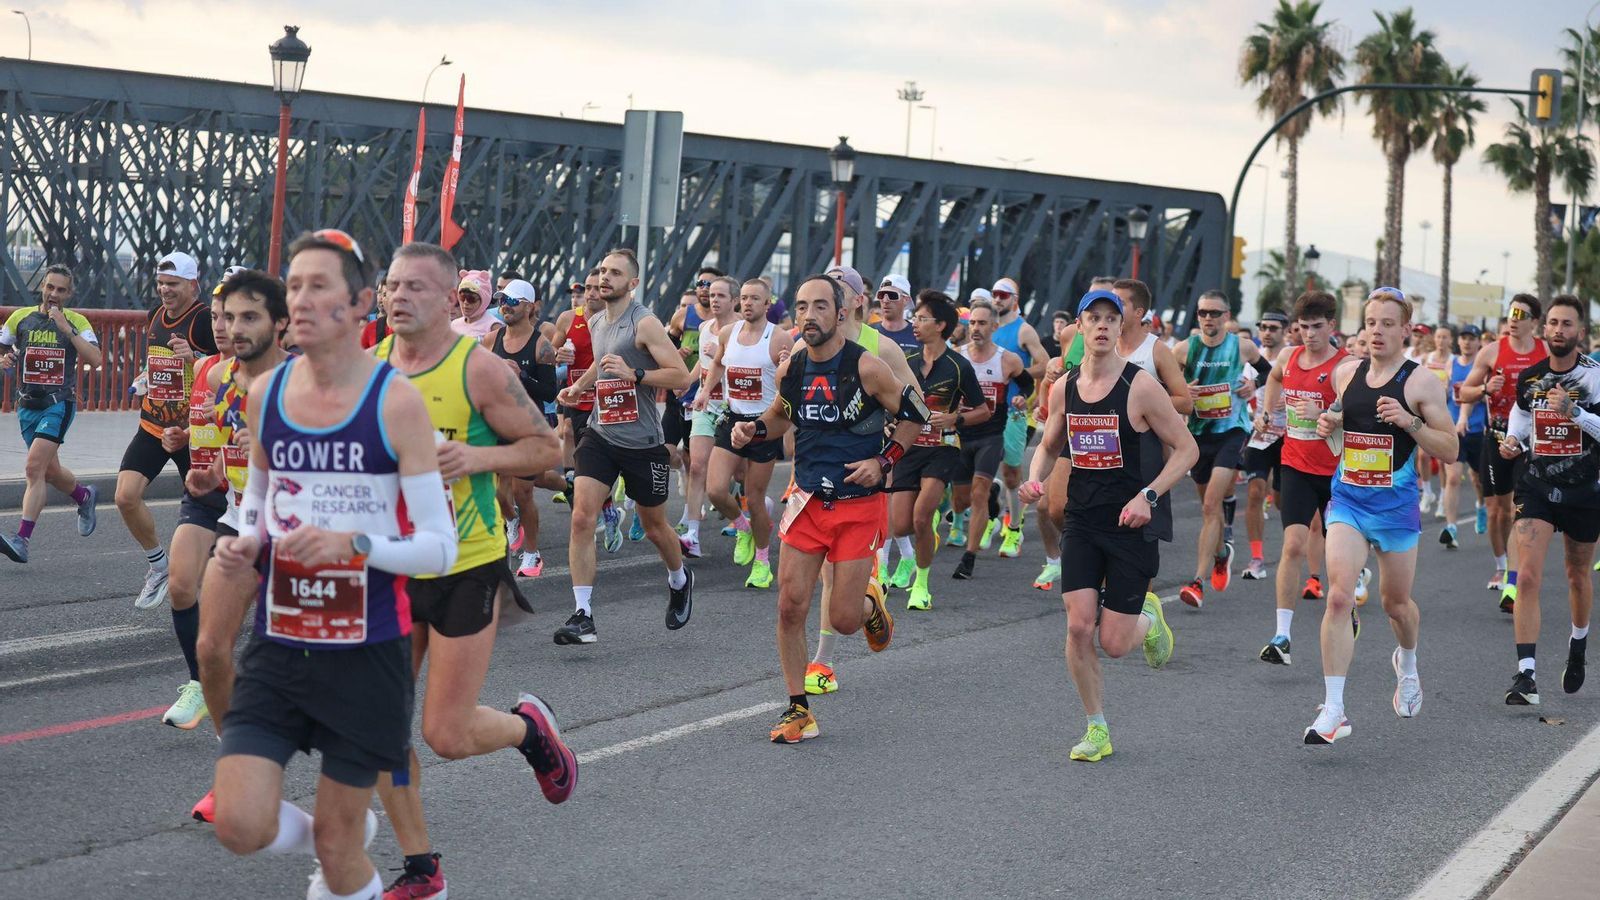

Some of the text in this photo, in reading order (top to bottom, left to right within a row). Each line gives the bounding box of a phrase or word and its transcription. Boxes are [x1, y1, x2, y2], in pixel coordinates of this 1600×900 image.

[28, 330, 57, 343] TRAIL
[34, 360, 54, 369] 5118
[154, 358, 180, 366] GENERALI
[152, 371, 172, 381] 6229
[734, 378, 753, 387] 6820
[1297, 390, 1322, 399] PEDRO
[1079, 417, 1114, 426] GENERALI
[1545, 426, 1568, 436] 2120
[1079, 434, 1105, 445] 5615
[272, 440, 364, 472] GOWER
[1353, 452, 1377, 463] 3190
[650, 462, 670, 496] NIKE
[312, 484, 372, 499] CANCER
[312, 500, 387, 514] RESEARCH
[311, 516, 331, 528] UK
[289, 577, 337, 599] 1644
